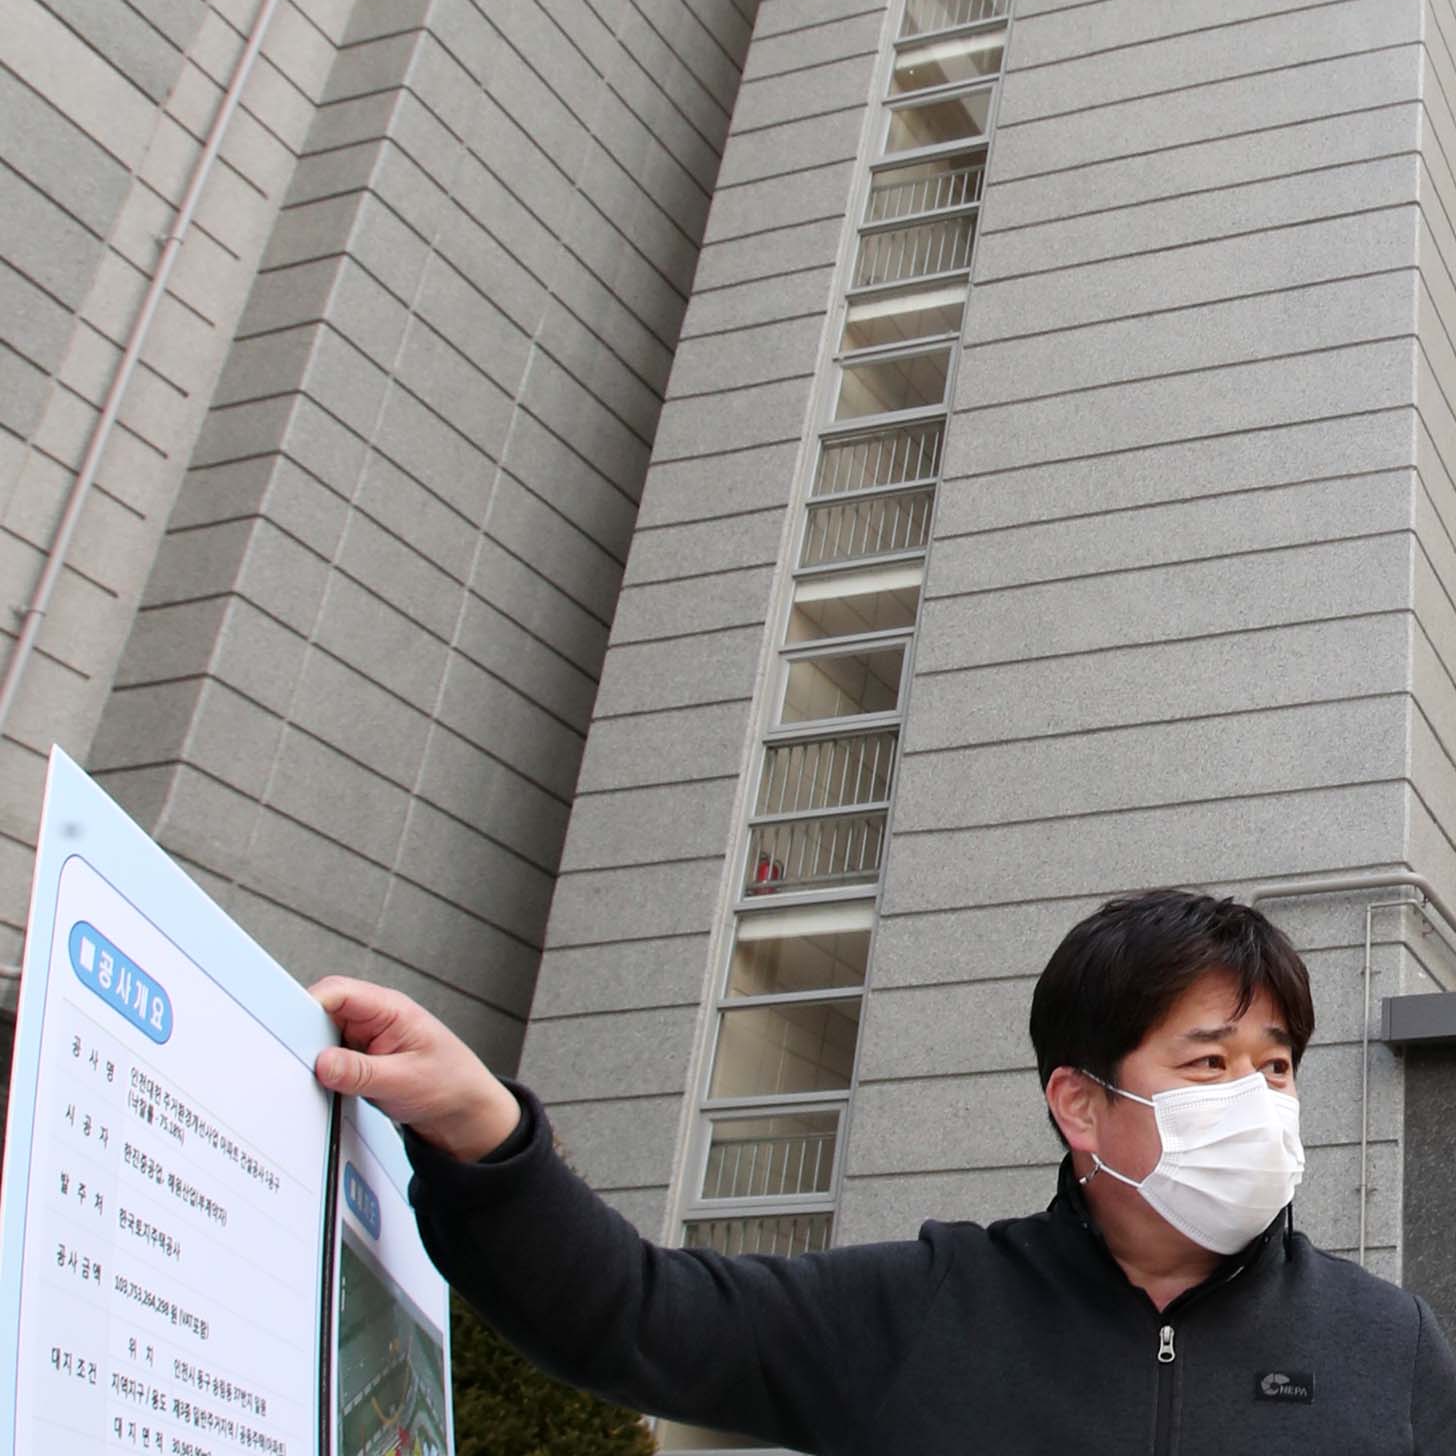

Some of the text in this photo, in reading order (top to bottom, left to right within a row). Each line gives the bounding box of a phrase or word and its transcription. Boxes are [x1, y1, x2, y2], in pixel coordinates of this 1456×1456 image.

[99, 950, 165, 1032] 공사개요
[219, 1135, 239, 1163] 아파트
[239, 1151, 265, 1184] 건설공사
[119, 1207, 181, 1261] 한국토지주택공사
[111, 1372, 145, 1404] 지역지구
[173, 1358, 196, 1387] 인천시
[196, 1368, 211, 1393] 동구
[212, 1376, 233, 1403] 송림동
[192, 1405, 234, 1441] 일반주거지역
